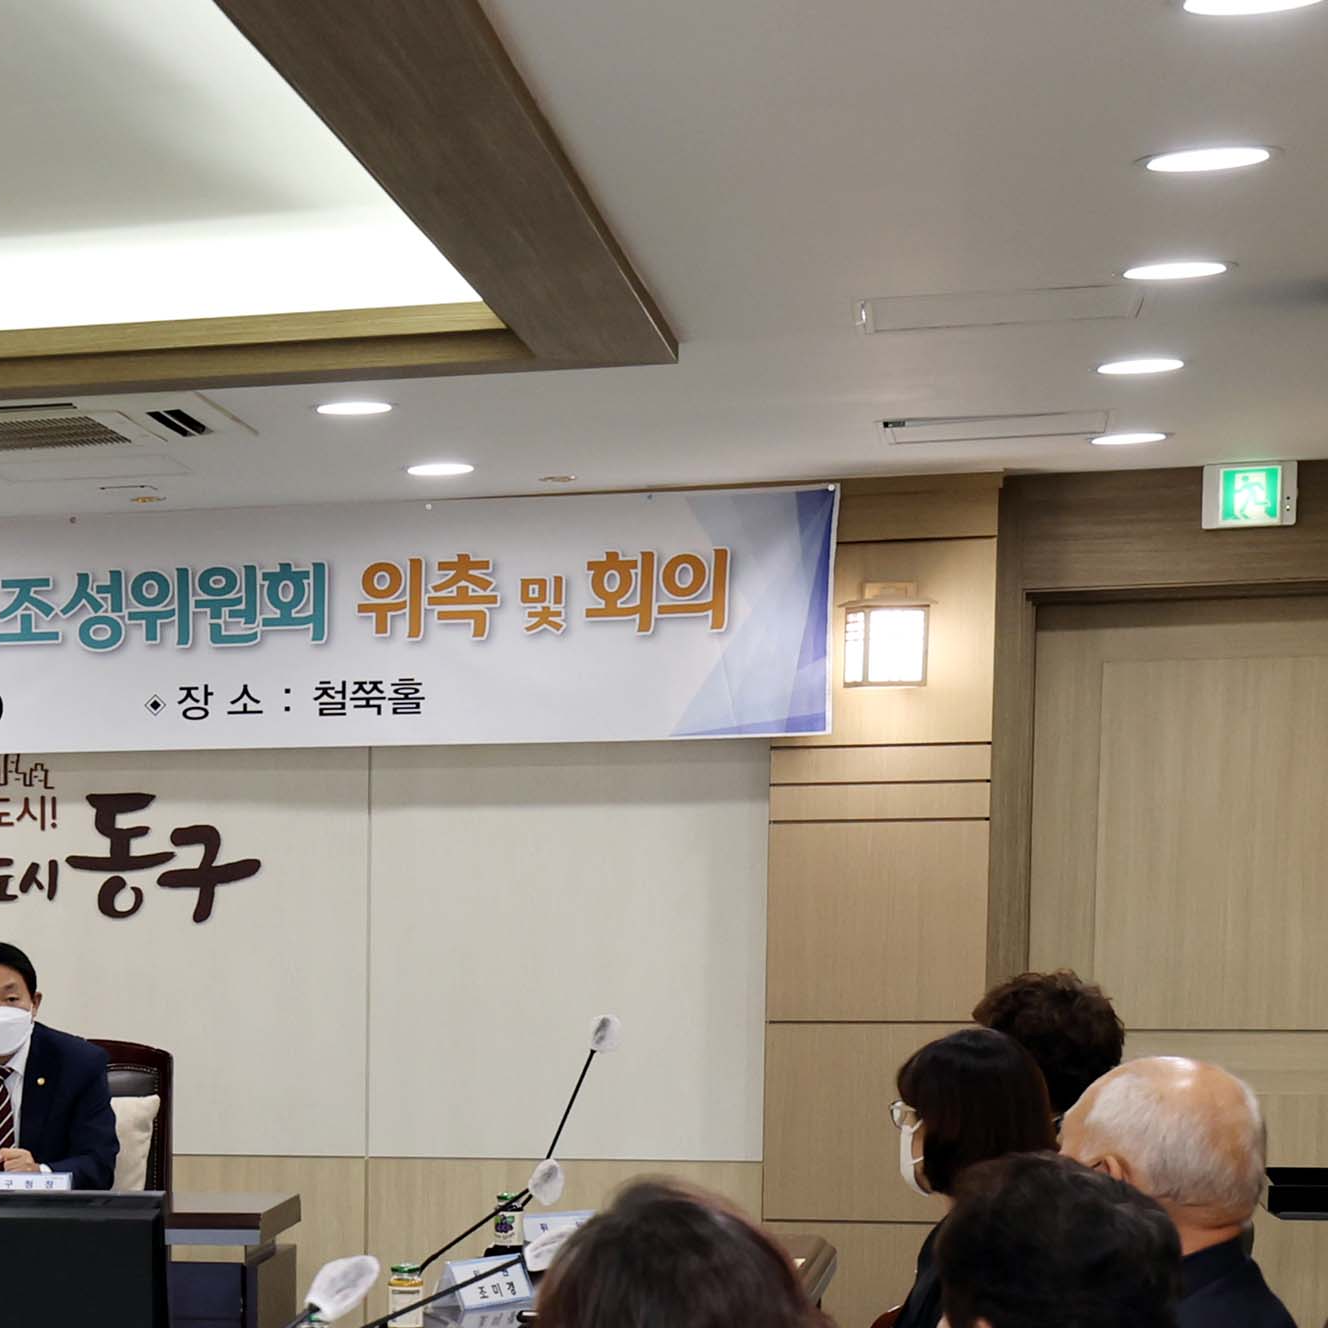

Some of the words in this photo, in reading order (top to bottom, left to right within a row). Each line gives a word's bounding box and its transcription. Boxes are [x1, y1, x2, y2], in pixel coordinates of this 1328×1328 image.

[357, 553, 500, 641] 위촉
[518, 575, 565, 633] 및
[584, 546, 730, 633] 회의
[313, 678, 425, 717] 철쭉홀
[65, 793, 261, 922] 동구
